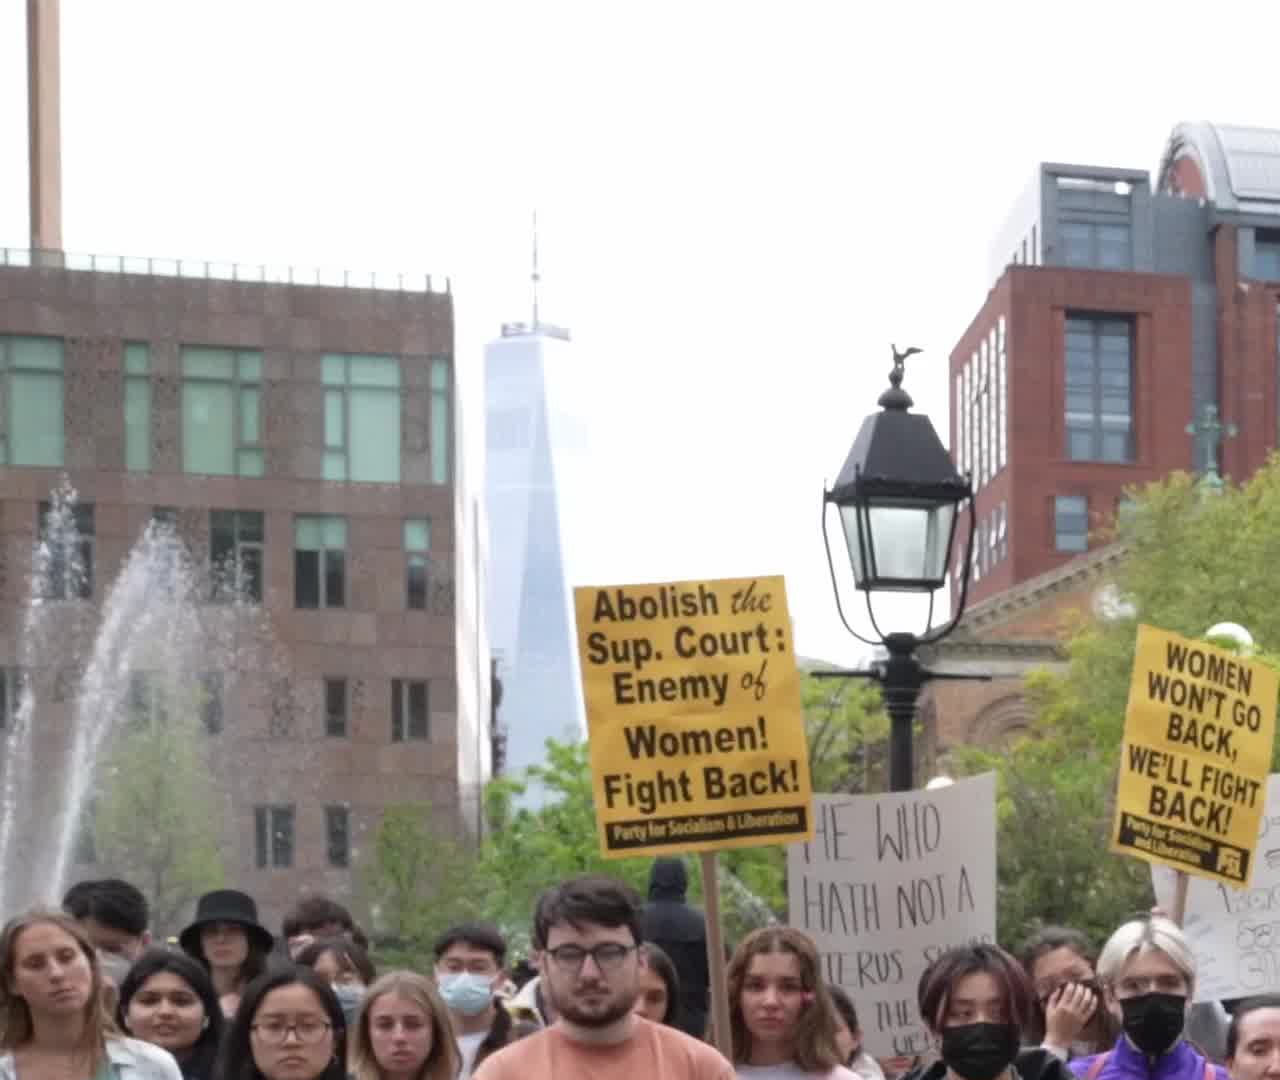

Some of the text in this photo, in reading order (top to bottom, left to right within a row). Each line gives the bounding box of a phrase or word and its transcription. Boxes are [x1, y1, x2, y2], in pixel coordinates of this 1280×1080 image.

[593, 580, 772, 622] Abolish the
[588, 631, 663, 670] Sup.
[1167, 641, 1252, 697] WOMEN
[613, 658, 768, 706] Enemy of
[1148, 671, 1262, 733] WON'T GO
[623, 716, 769, 760] Women!
[1167, 713, 1238, 762] BACK,
[604, 759, 800, 814] Fight Back!
[1129, 744, 1261, 808] WE'LL FIGHT
[804, 801, 941, 864] HE WHO
[1148, 785, 1233, 836] BACK!
[803, 863, 975, 936] HATH NOT A
[820, 949, 904, 989] TERUS
